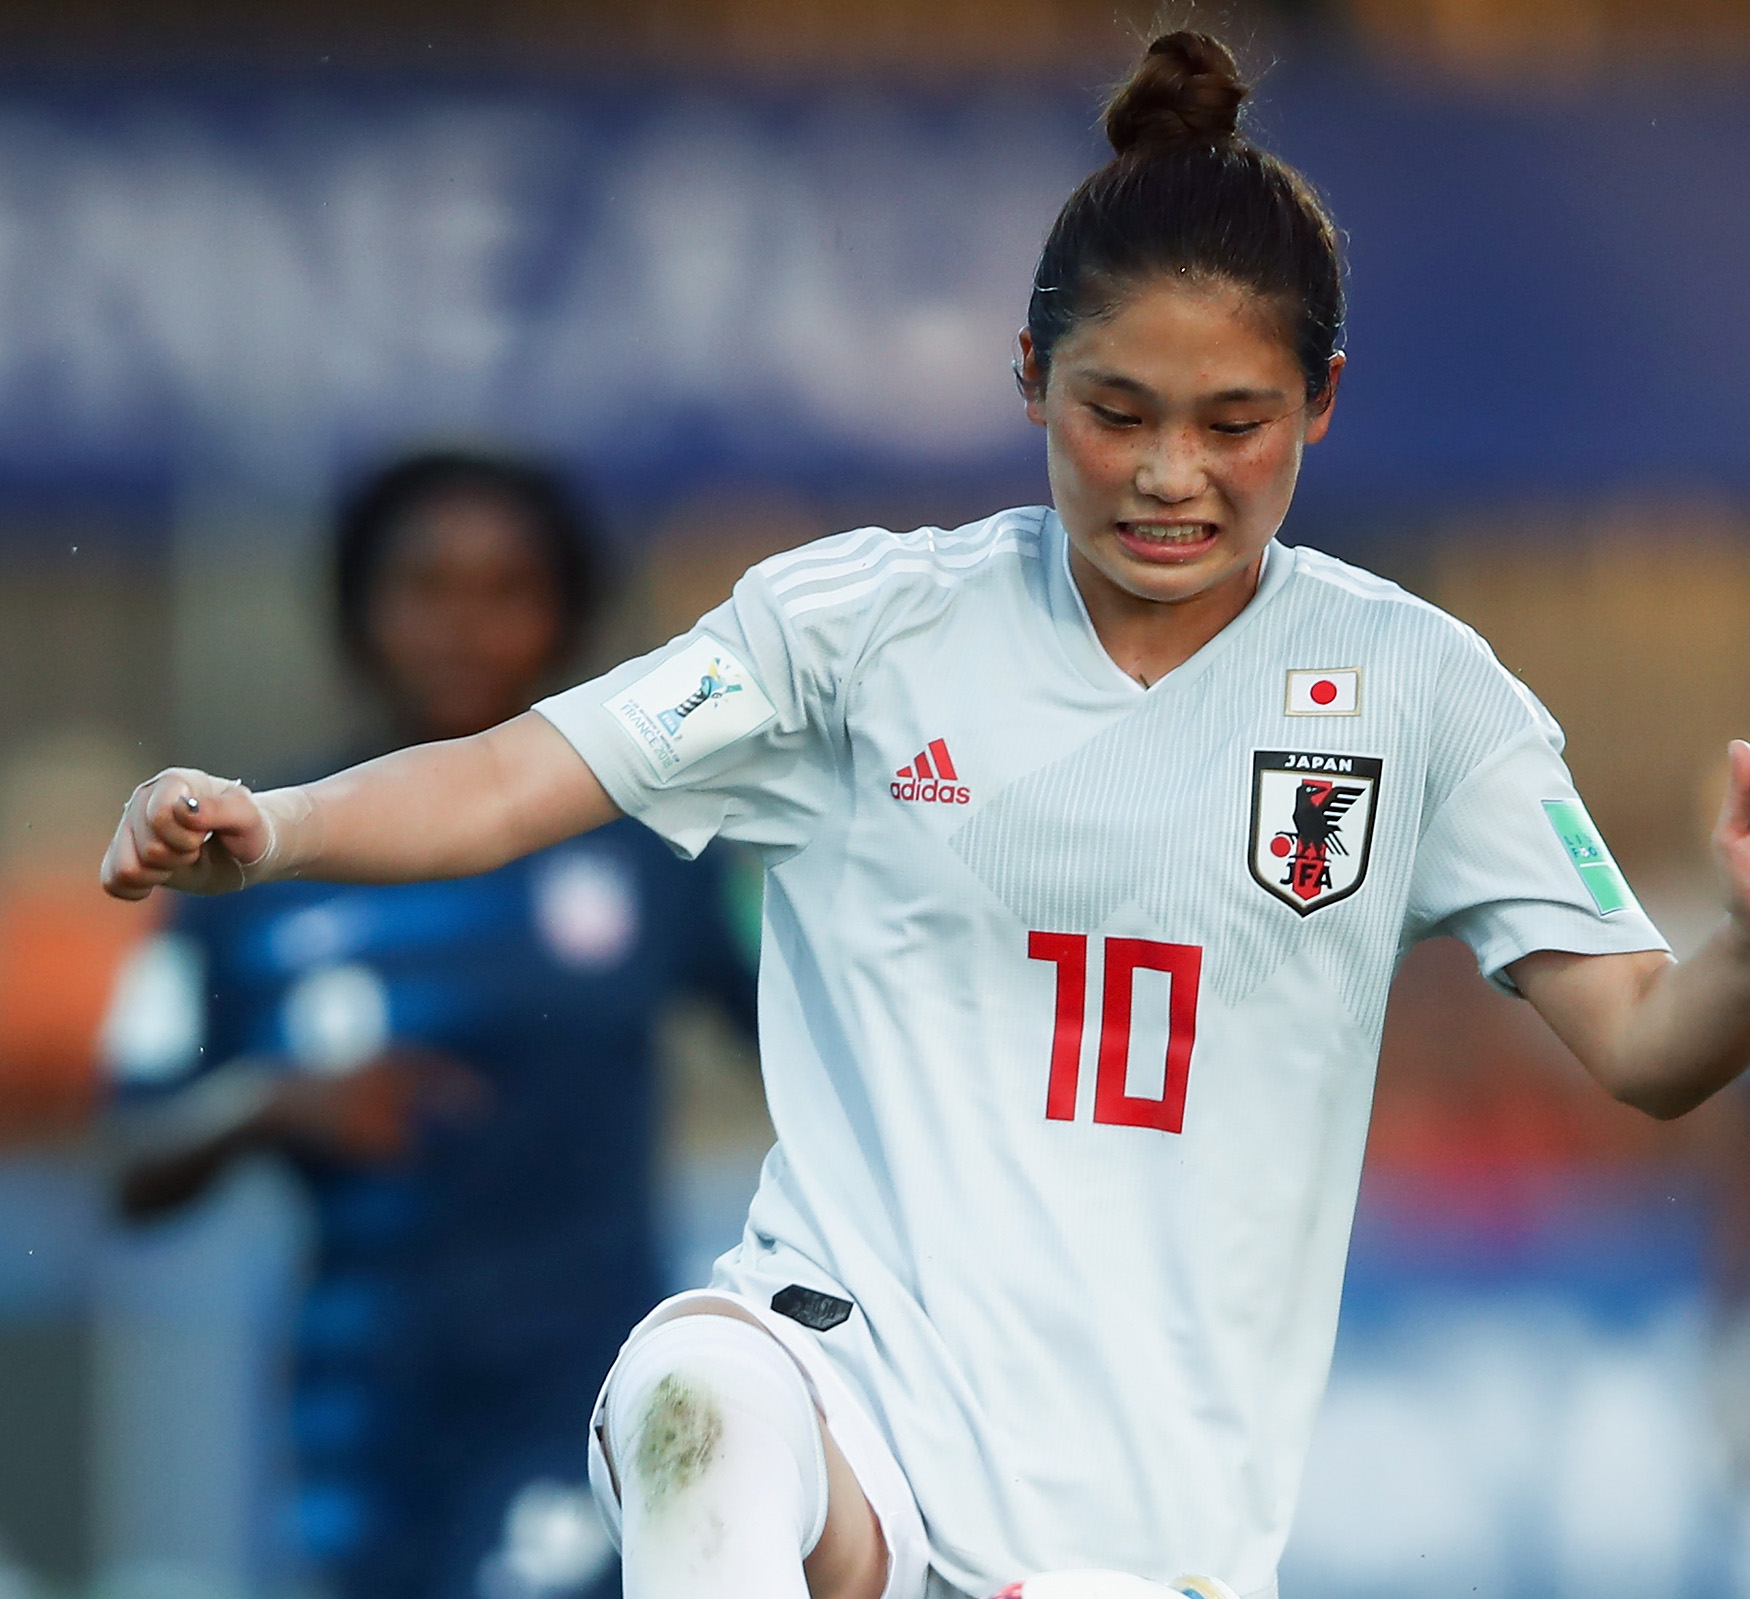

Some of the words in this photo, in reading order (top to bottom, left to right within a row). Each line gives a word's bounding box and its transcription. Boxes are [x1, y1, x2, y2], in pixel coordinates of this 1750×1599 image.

[620, 704, 660, 748] FRANCE
[654, 746, 674, 769] 2018
[1285, 755, 1353, 772] JAPAN
[890, 778, 971, 805] adidas
[1279, 862, 1333, 889] JFA
[1028, 931, 1203, 1134] 10
